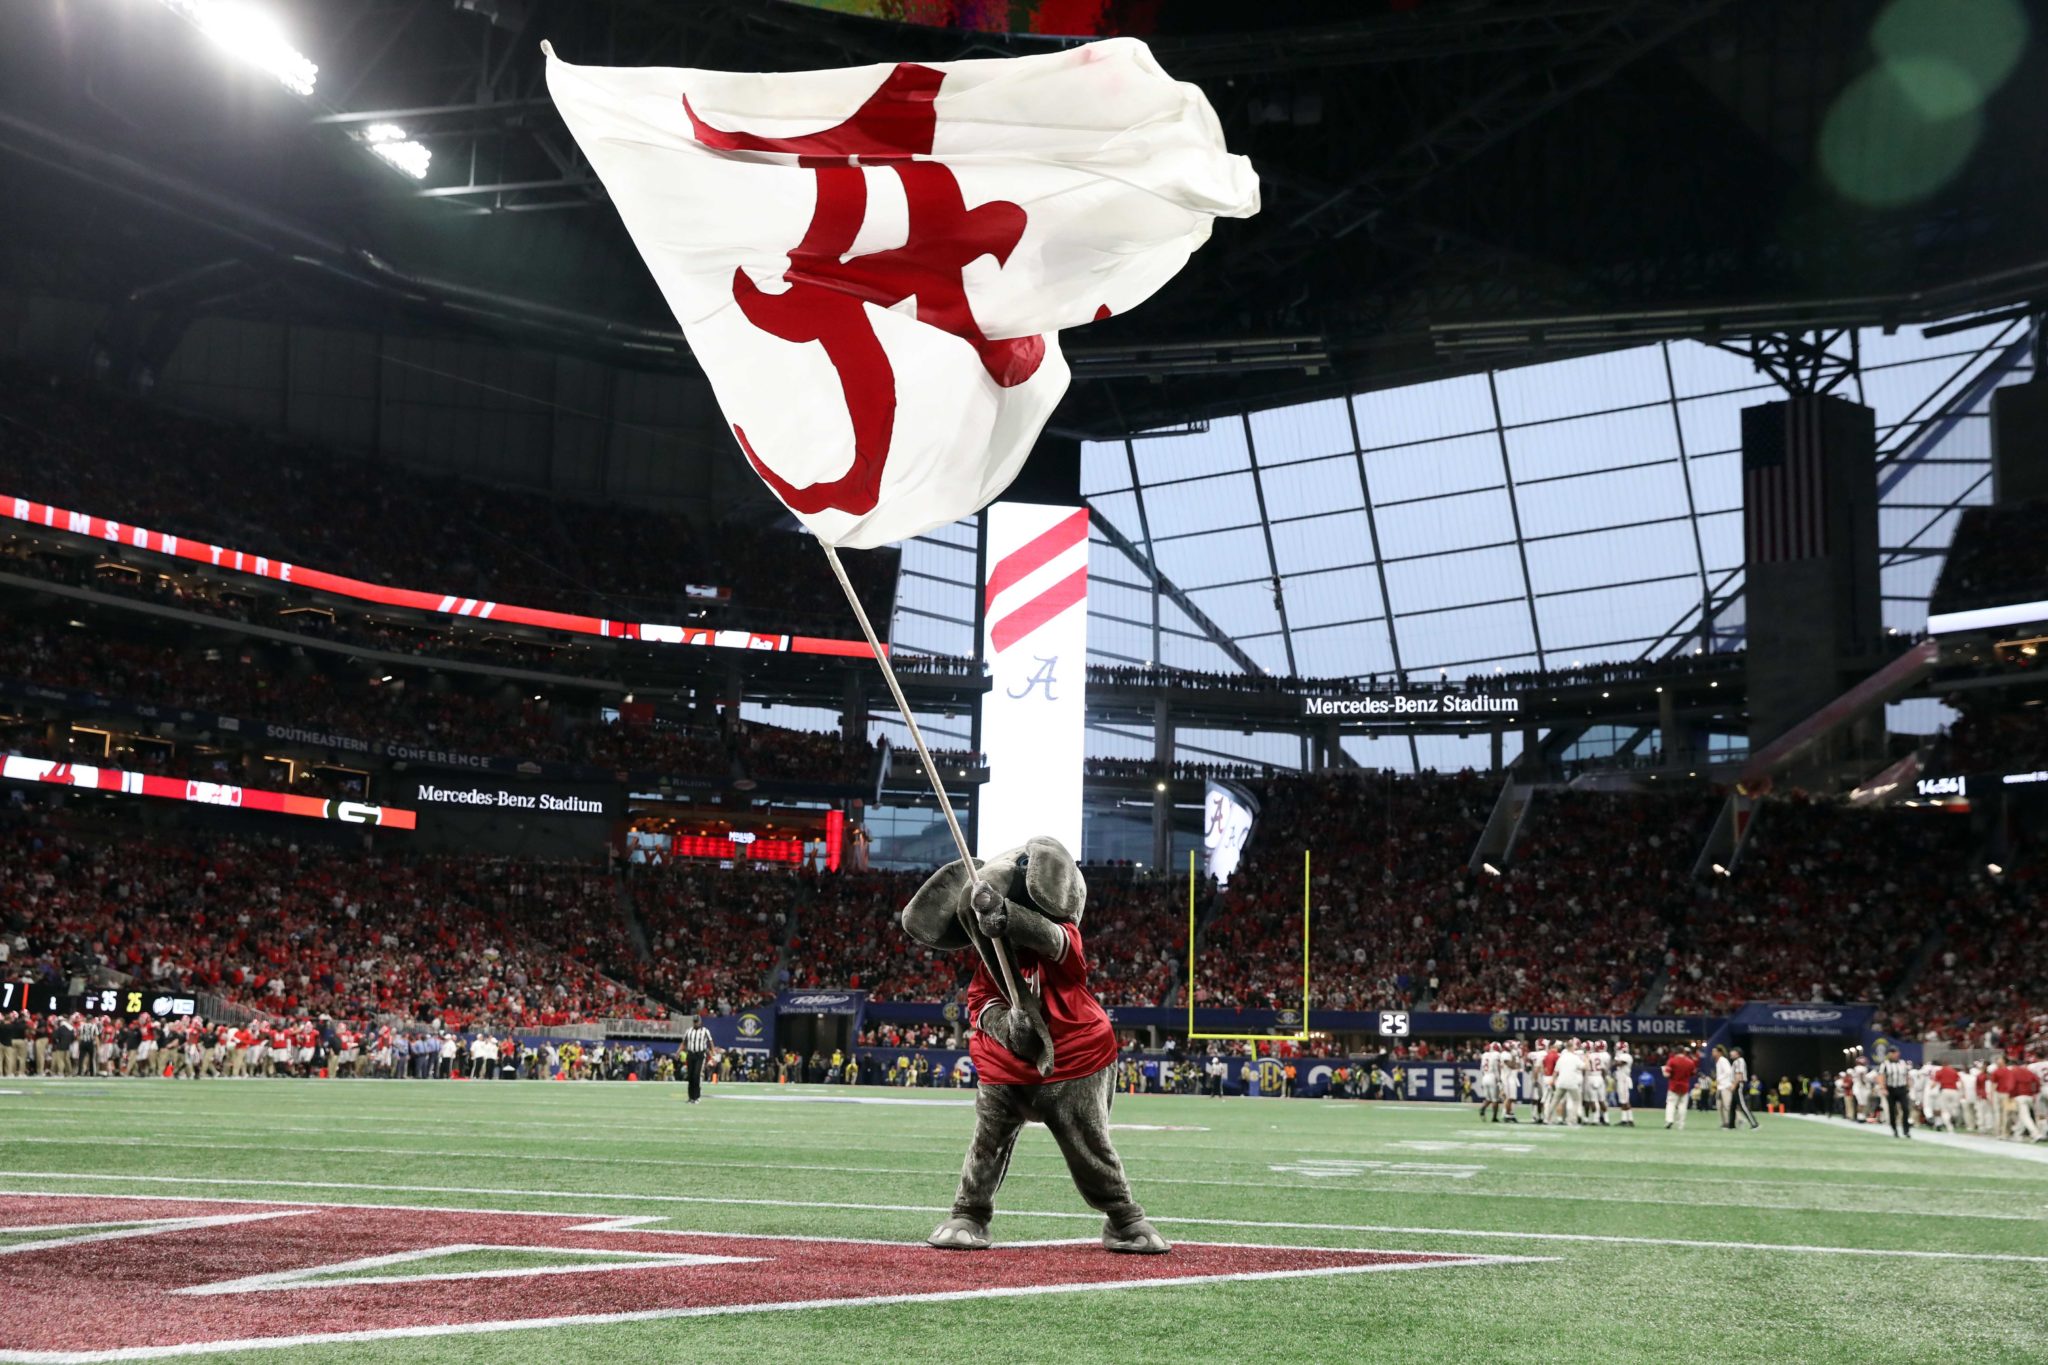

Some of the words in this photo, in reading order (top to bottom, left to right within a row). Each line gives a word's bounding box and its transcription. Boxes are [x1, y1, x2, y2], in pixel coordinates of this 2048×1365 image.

[1007, 655, 1059, 701] A
[1305, 695, 1438, 714] Mercedes-Benz
[1443, 695, 1519, 712] Stadium
[266, 725, 369, 751] SOUTHEASTERN
[387, 745, 491, 768] CONFERENCE
[418, 784, 536, 809] Mercedes-Benz
[539, 793, 604, 813] Stadium
[100, 990, 118, 1012] 35
[126, 991, 143, 1013] 25
[1381, 1014, 1409, 1034] 25
[1514, 1017, 1529, 1030] IT
[1531, 1017, 1570, 1032] JUST
[1574, 1019, 1633, 1034] MEANS
[1637, 1020, 1691, 1035] MORE.
